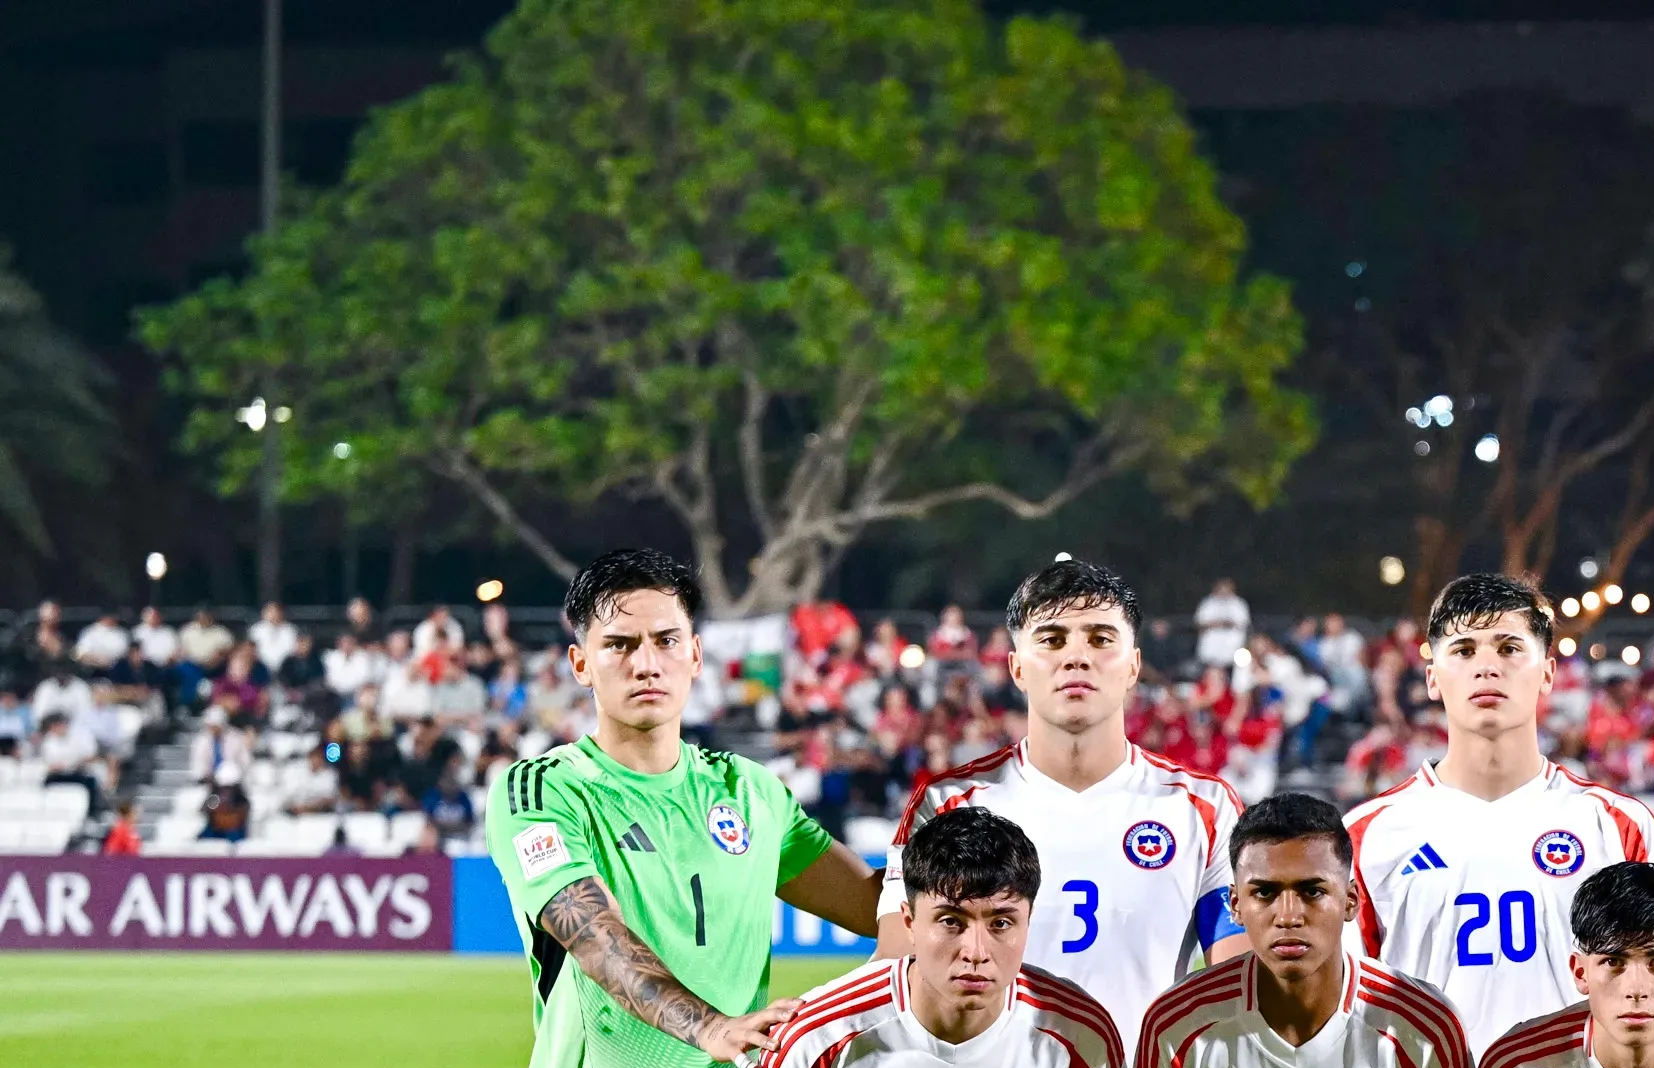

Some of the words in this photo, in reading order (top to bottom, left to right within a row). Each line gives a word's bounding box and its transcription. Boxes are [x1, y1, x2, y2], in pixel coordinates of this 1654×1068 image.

[0, 871, 93, 937] AR
[108, 872, 432, 940] AIRWAYS
[690, 873, 706, 946] 1
[1062, 880, 1098, 953] 3
[1454, 890, 1536, 966] 20
